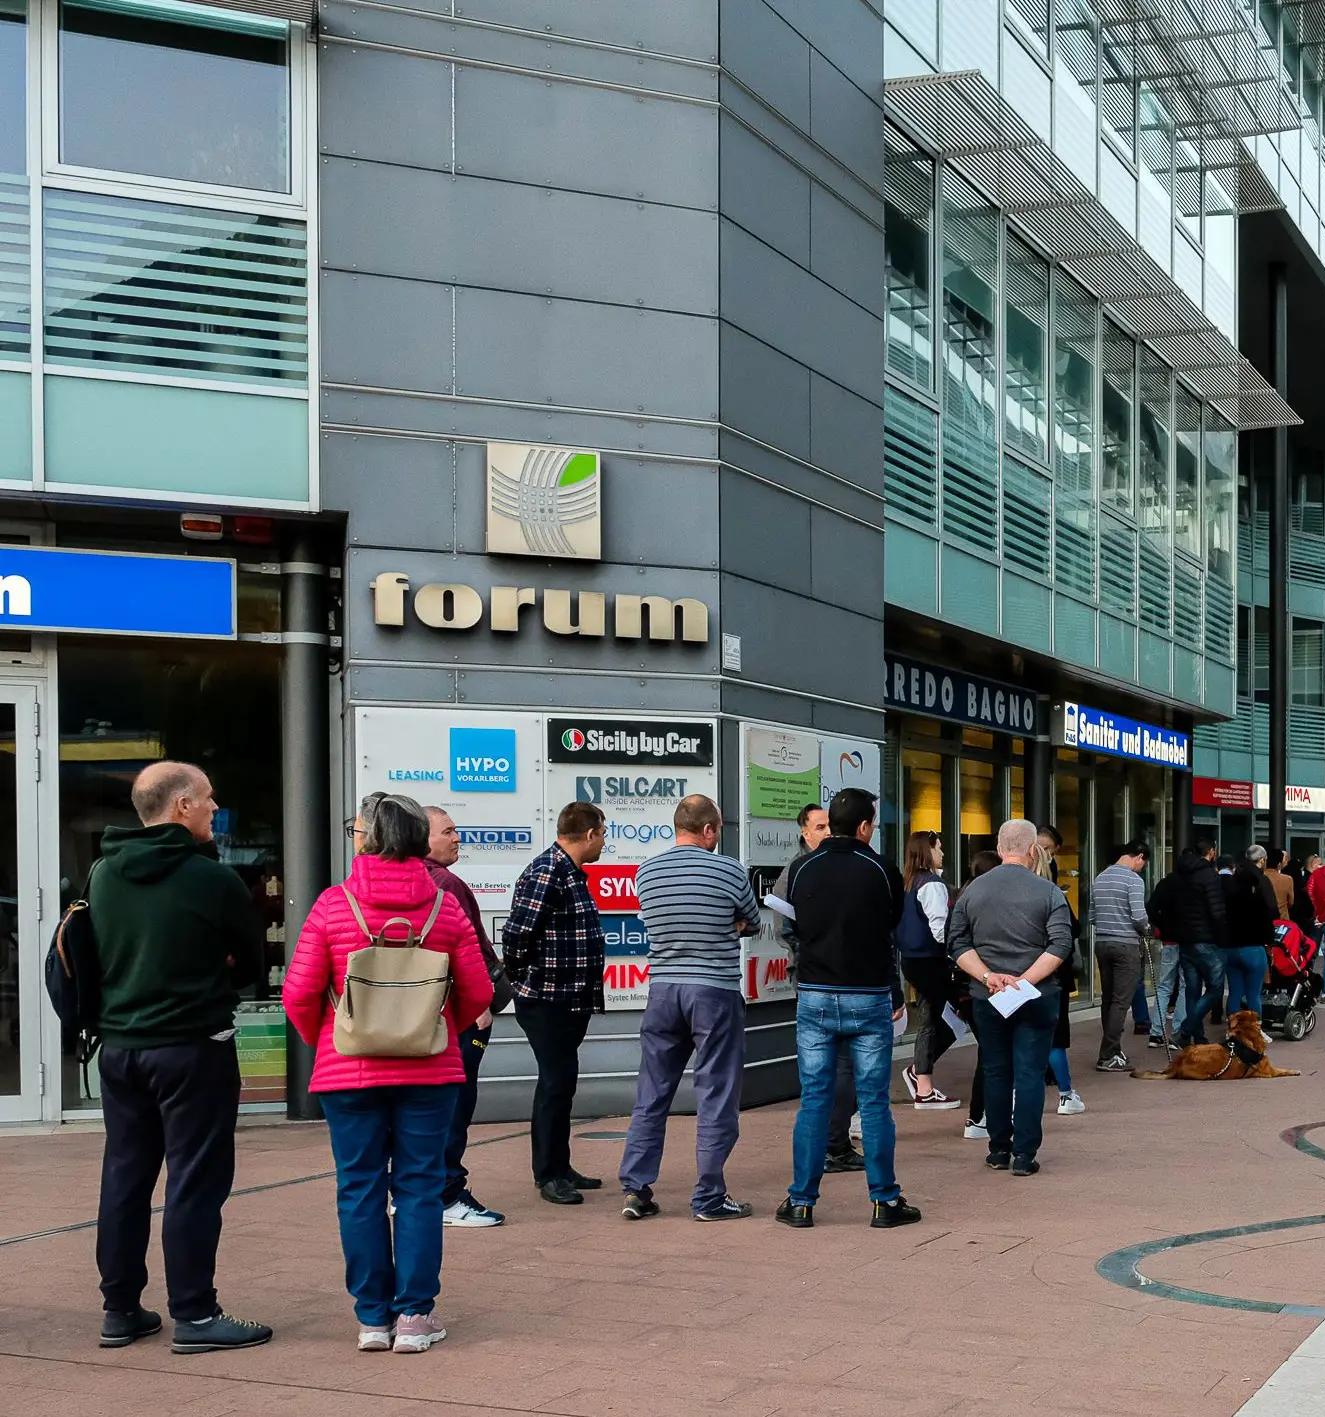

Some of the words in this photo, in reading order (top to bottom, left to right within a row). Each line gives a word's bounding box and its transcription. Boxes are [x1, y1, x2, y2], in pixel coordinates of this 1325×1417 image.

[369, 572, 709, 642] forum
[967, 682, 1033, 731] BAGNO
[1079, 712, 1120, 751] Sanitär
[1122, 726, 1141, 755] und
[1143, 729, 1188, 766] Badmöbel
[456, 756, 510, 773] HYPO
[388, 769, 445, 781] LEASING
[457, 774, 510, 783] VORARLBERG
[605, 776, 688, 798] SILCART
[607, 994, 629, 1003] Systec
